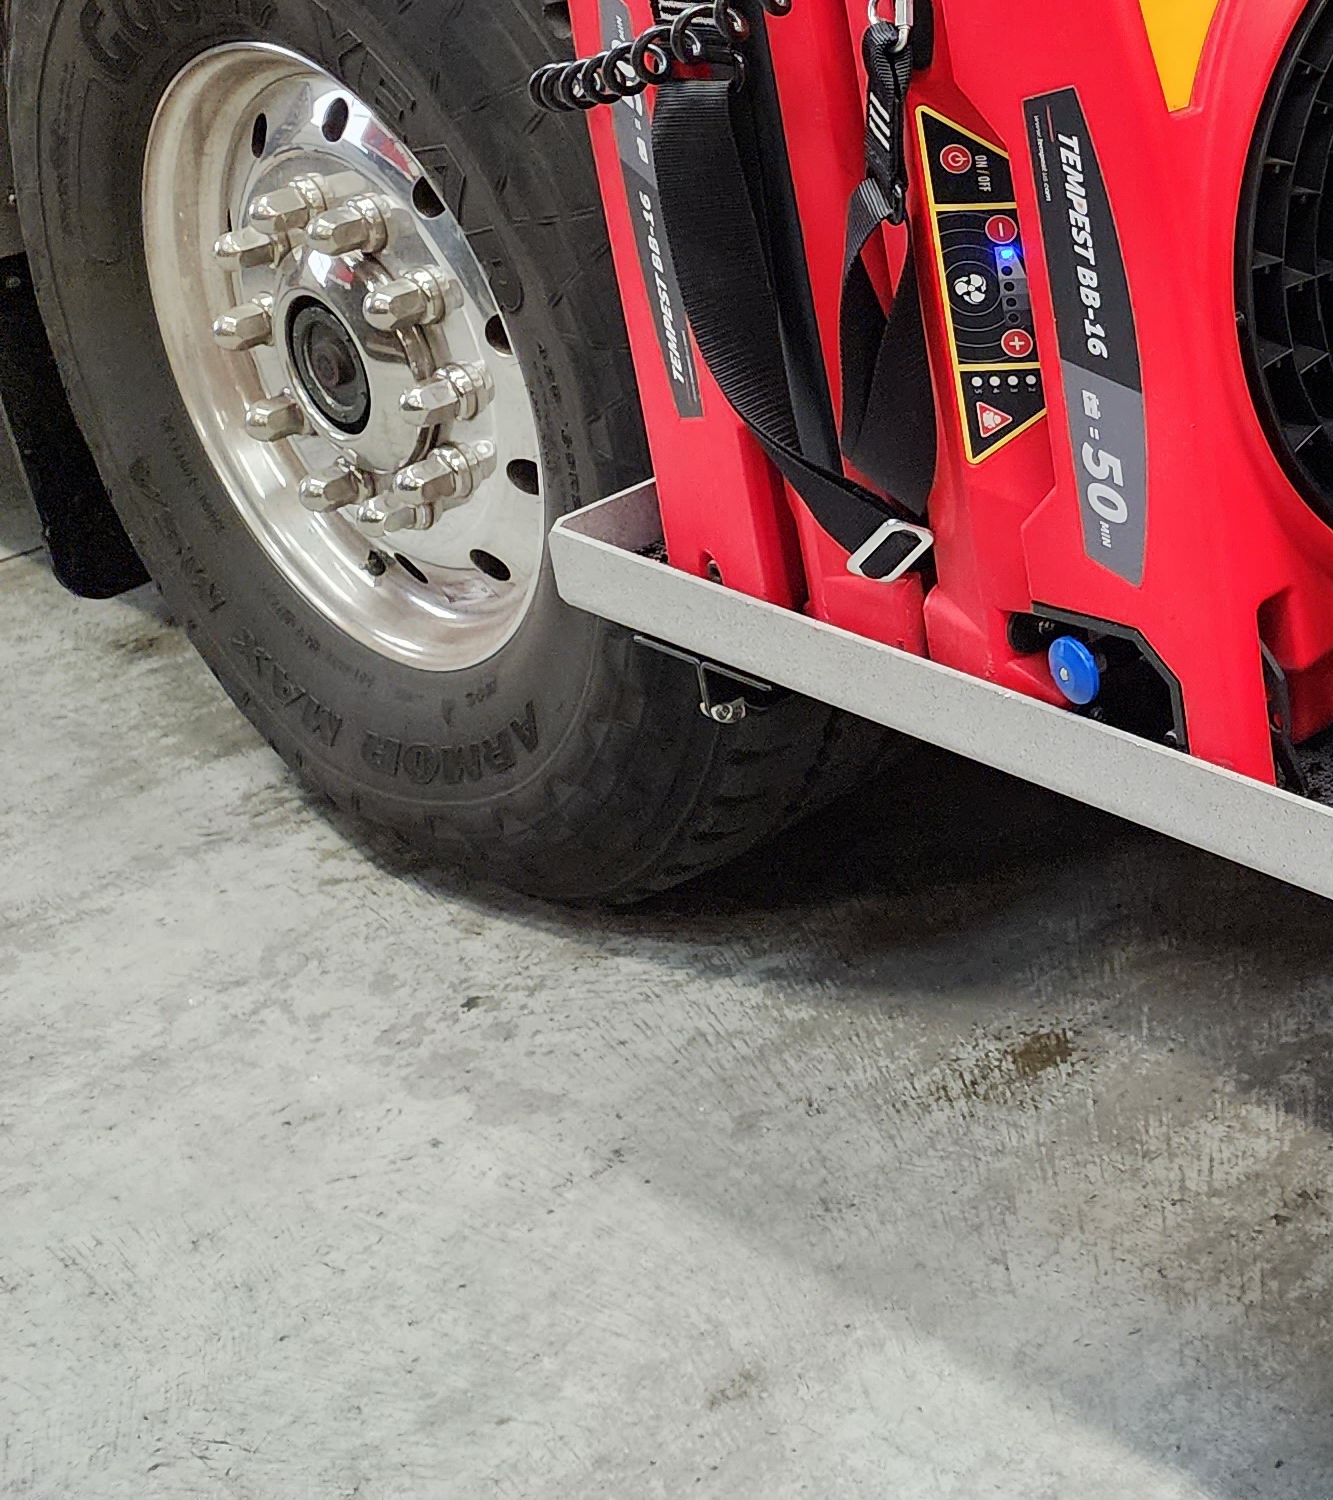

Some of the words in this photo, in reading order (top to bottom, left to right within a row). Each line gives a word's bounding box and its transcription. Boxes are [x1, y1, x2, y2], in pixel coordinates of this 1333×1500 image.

[974, 155, 987, 168] ON
[978, 176, 992, 193] OFF
[1057, 133, 1096, 266] TEMPEST
[639, 190, 664, 274] BB-16
[654, 271, 684, 384] TEMPEST
[1077, 265, 1108, 359] BB-16
[1082, 441, 1128, 524] 50
[1100, 520, 1112, 548] MIN
[229, 626, 344, 748] MAX
[361, 700, 540, 787] ARMOR
